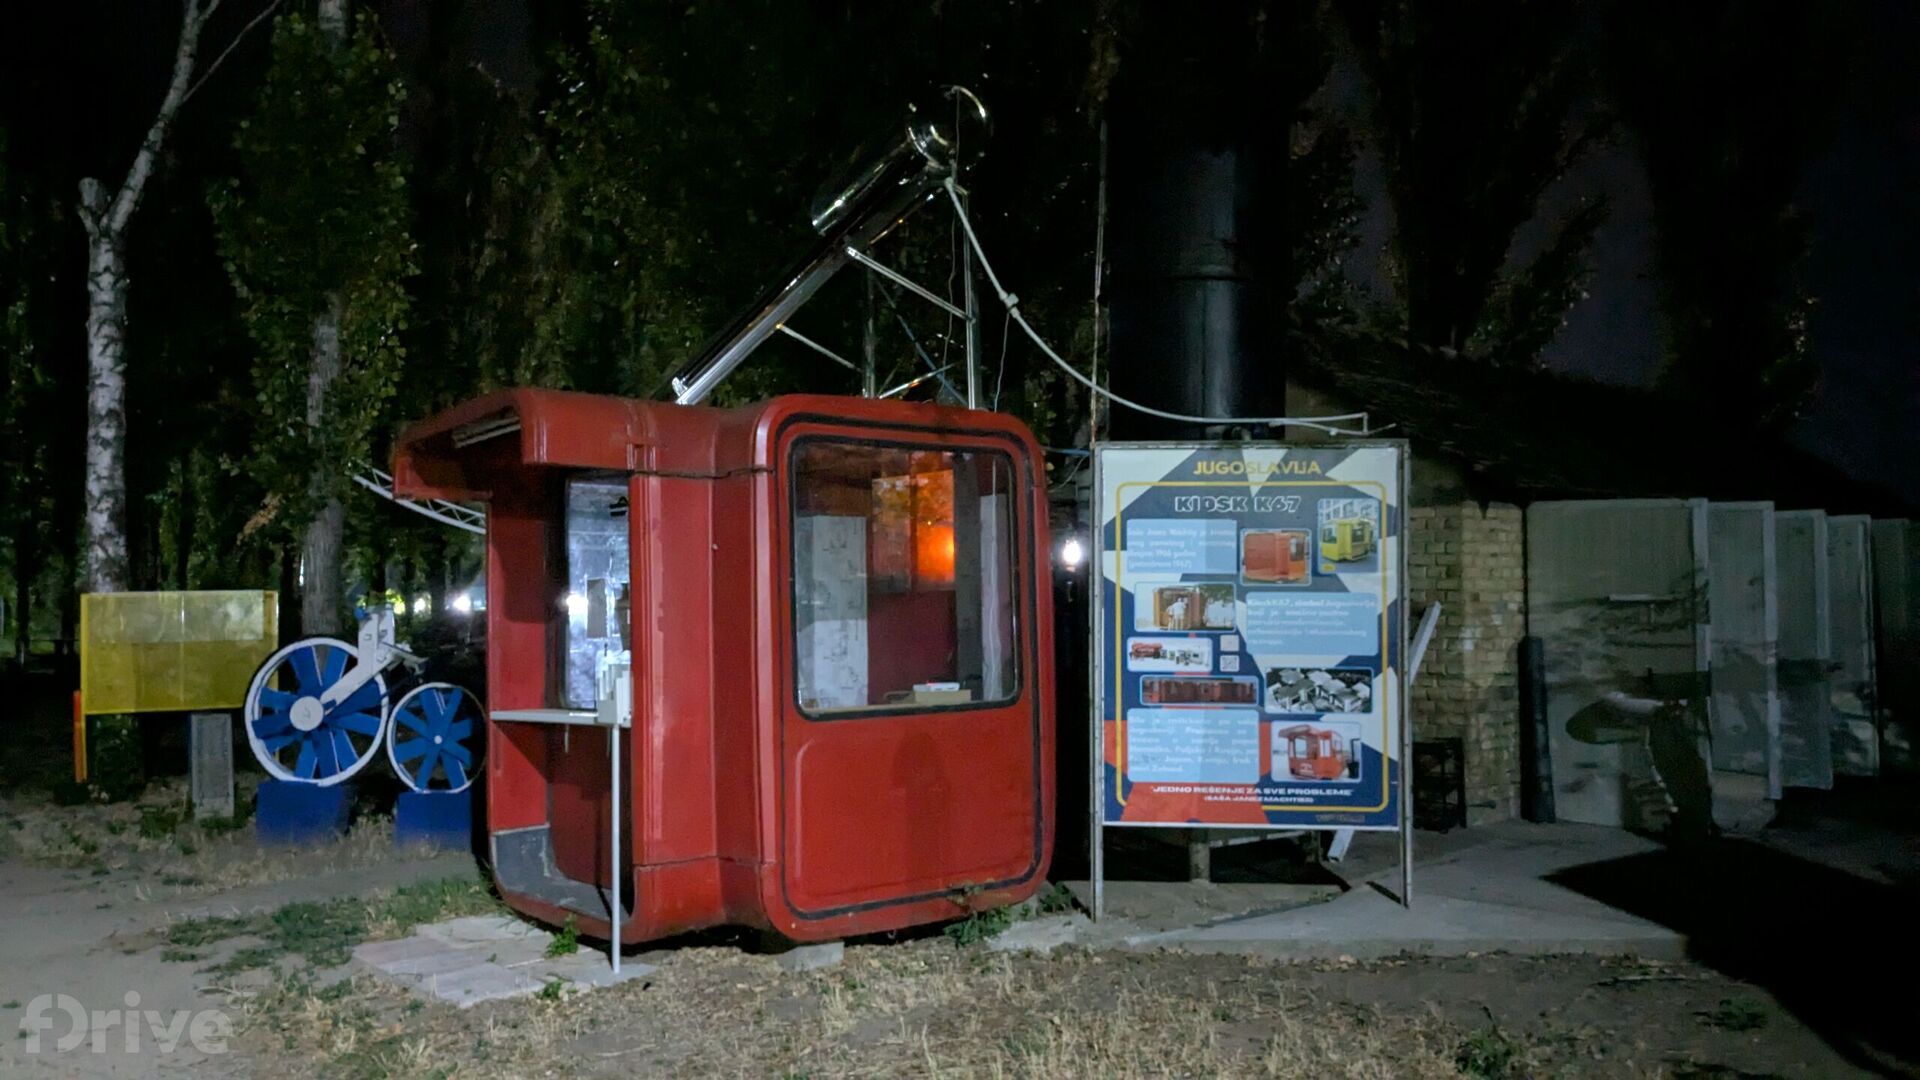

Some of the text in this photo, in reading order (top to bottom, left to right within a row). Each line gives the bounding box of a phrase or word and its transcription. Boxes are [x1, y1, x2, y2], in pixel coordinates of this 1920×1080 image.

[1193, 461, 1322, 475] JUGOSLAVIJA
[1174, 495, 1302, 513] KIOSK K67
